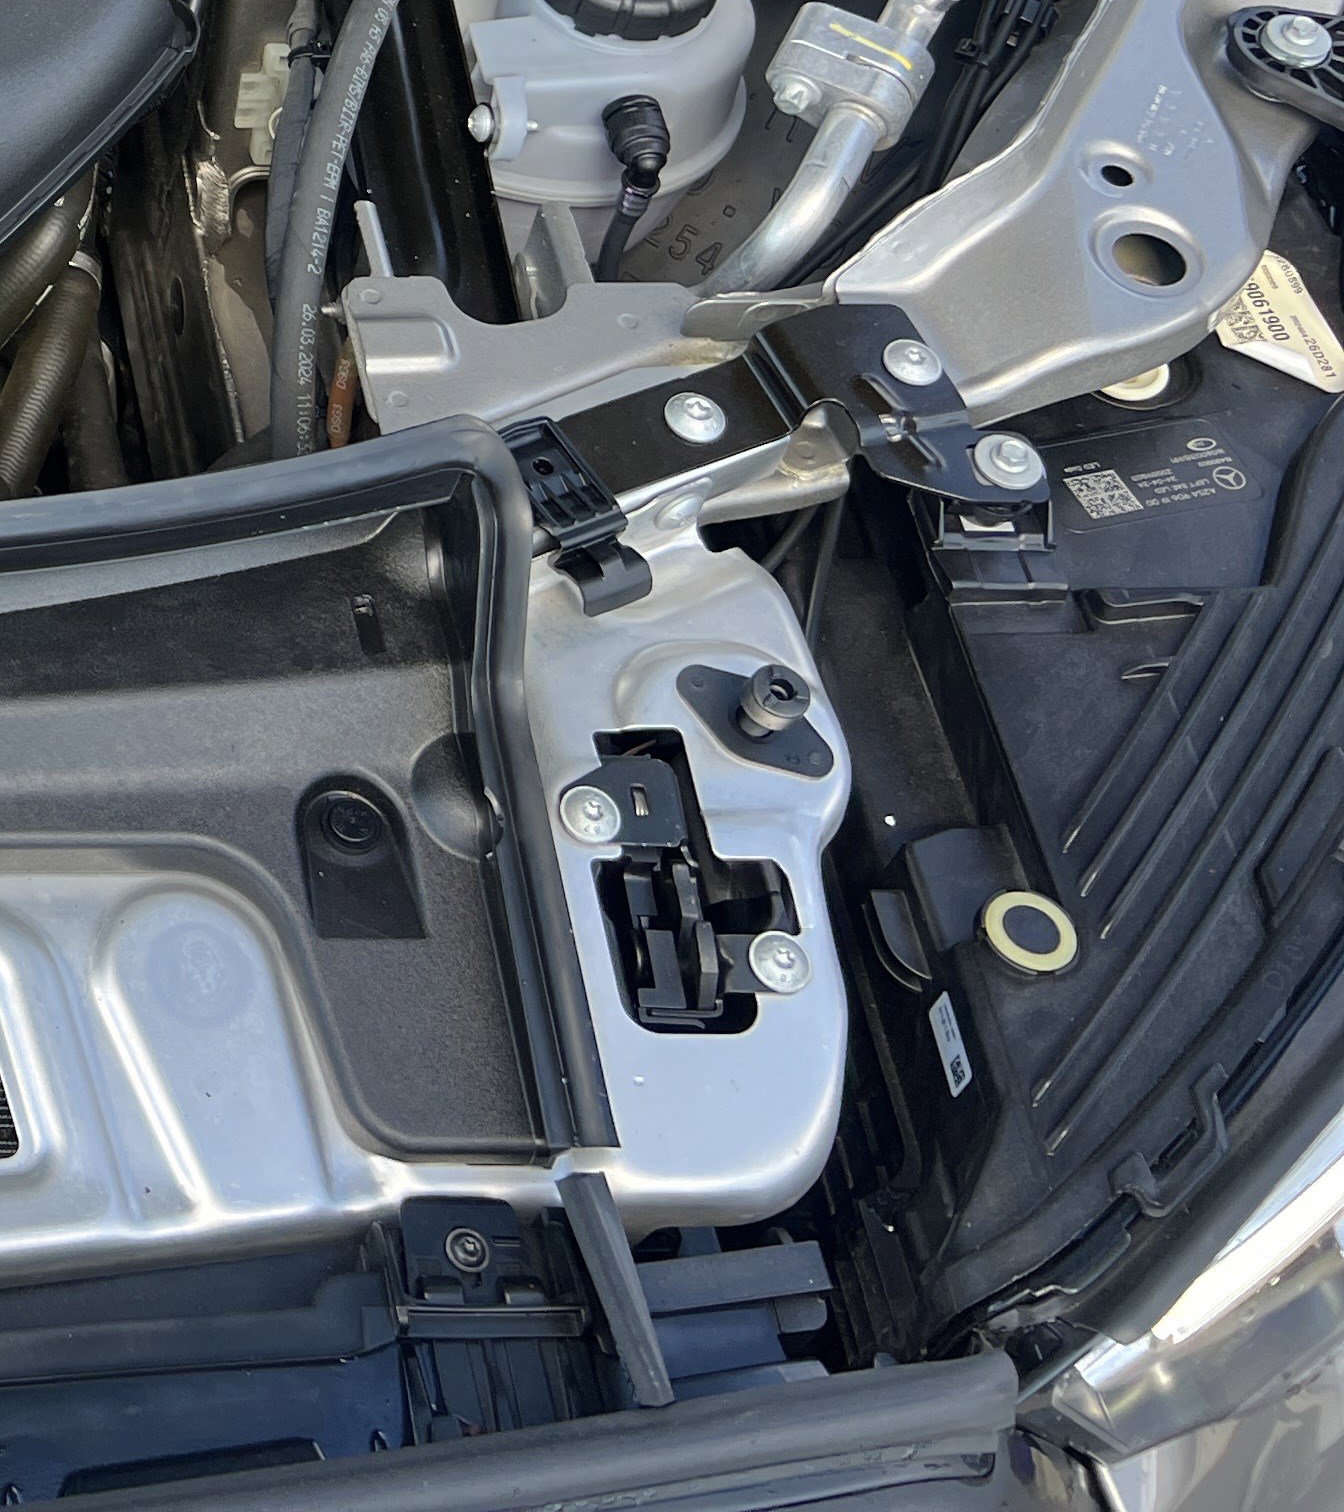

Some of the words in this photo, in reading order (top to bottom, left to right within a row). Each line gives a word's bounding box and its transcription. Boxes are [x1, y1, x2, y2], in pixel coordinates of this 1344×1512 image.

[307, 206, 331, 276] BA1214-2
[298, 303, 316, 386] 26.03.2024
[1303, 337, 1337, 379] 26D281
